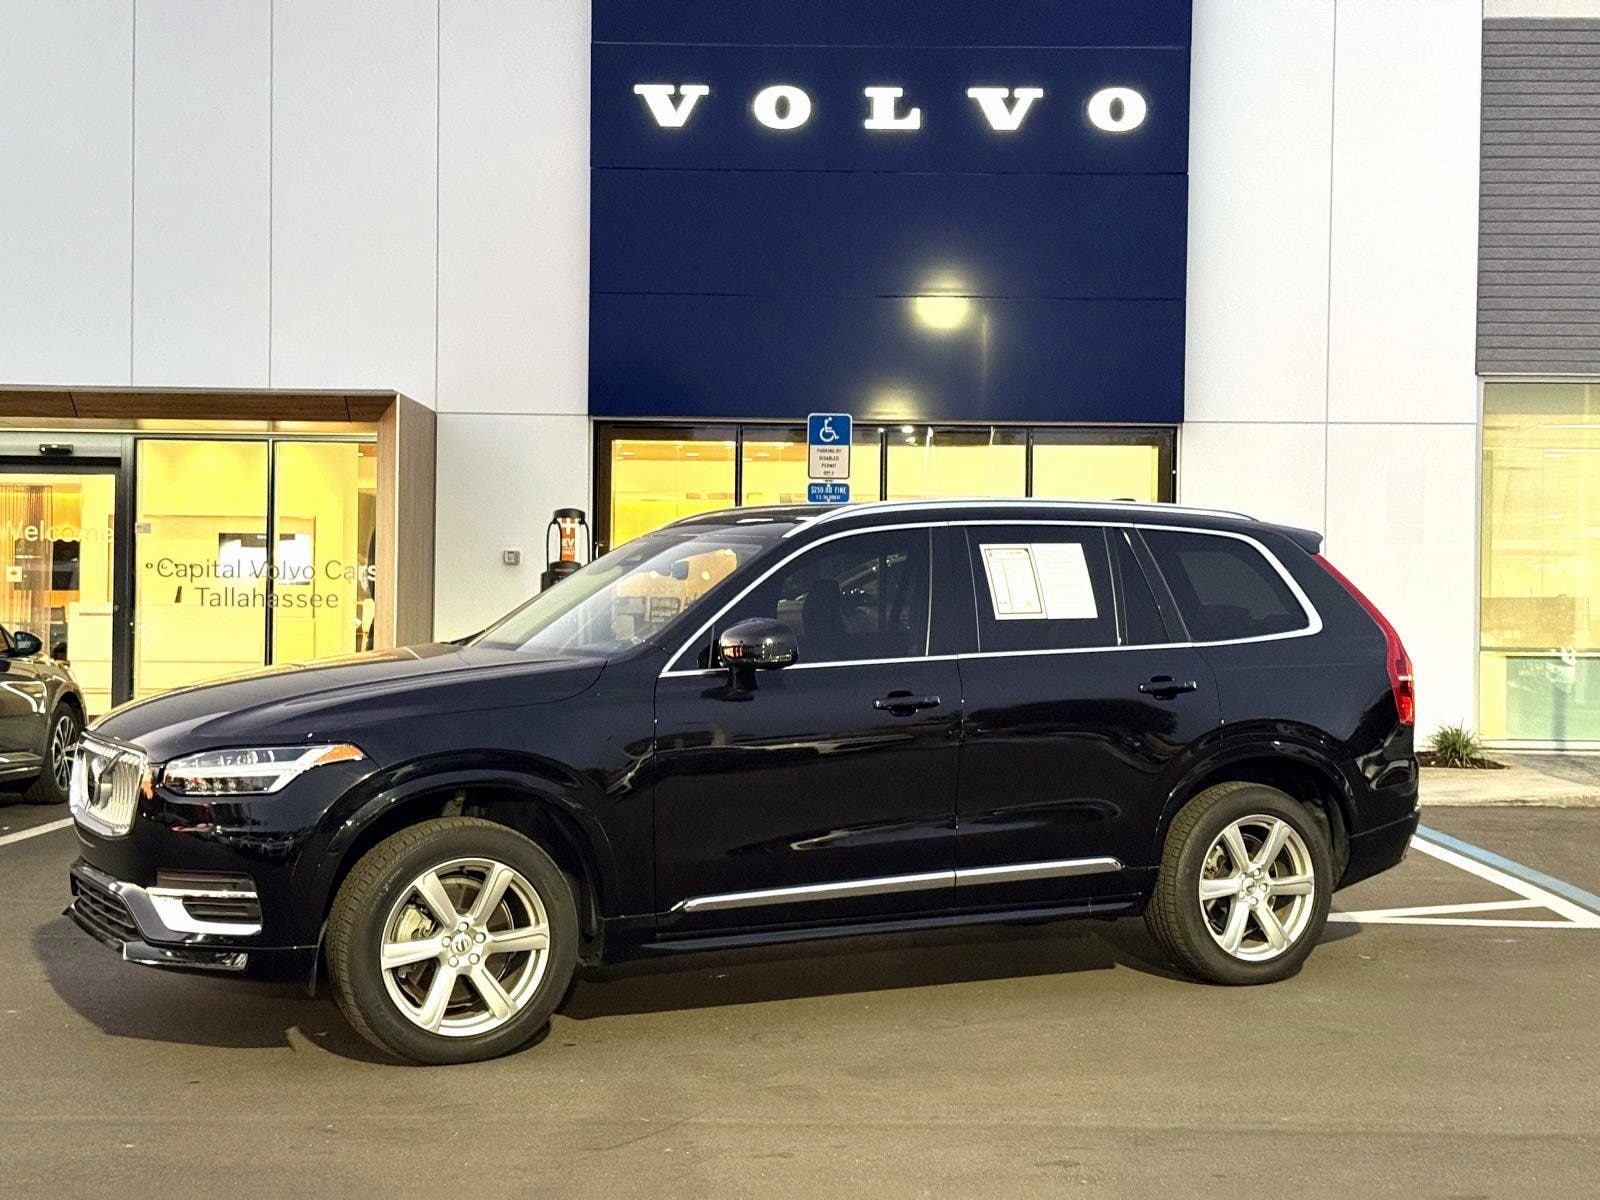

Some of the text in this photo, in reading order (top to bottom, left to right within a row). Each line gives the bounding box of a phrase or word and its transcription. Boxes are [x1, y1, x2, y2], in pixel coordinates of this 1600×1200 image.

[633, 83, 1148, 133] VOLVO
[834, 486, 847, 494] FINE
[157, 557, 240, 583] Capital
[250, 559, 315, 580] Volvo
[194, 586, 339, 608] Tallahassee
